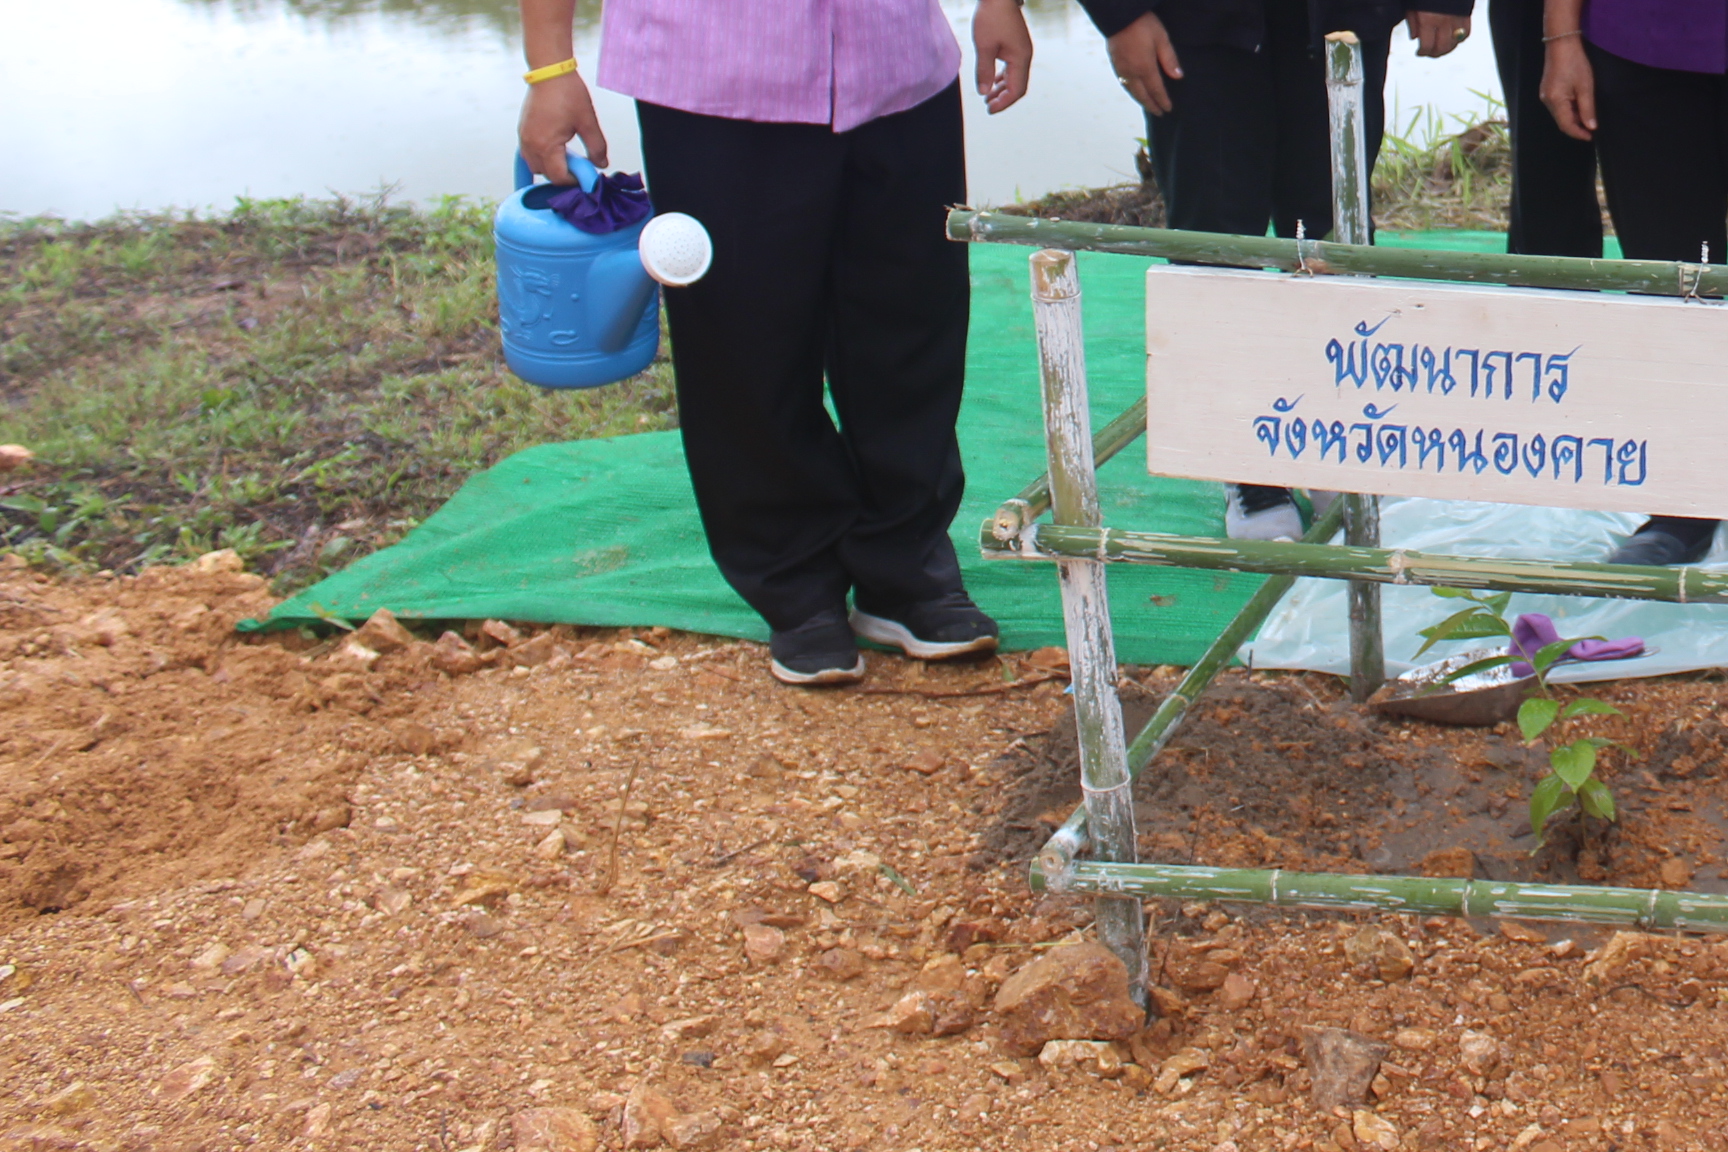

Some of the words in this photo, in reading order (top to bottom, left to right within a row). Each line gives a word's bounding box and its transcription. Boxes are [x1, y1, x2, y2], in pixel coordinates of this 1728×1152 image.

[1324, 315, 1583, 405] พัฒนาการ
[1252, 393, 1648, 488] จังหวัดหนองคาย
